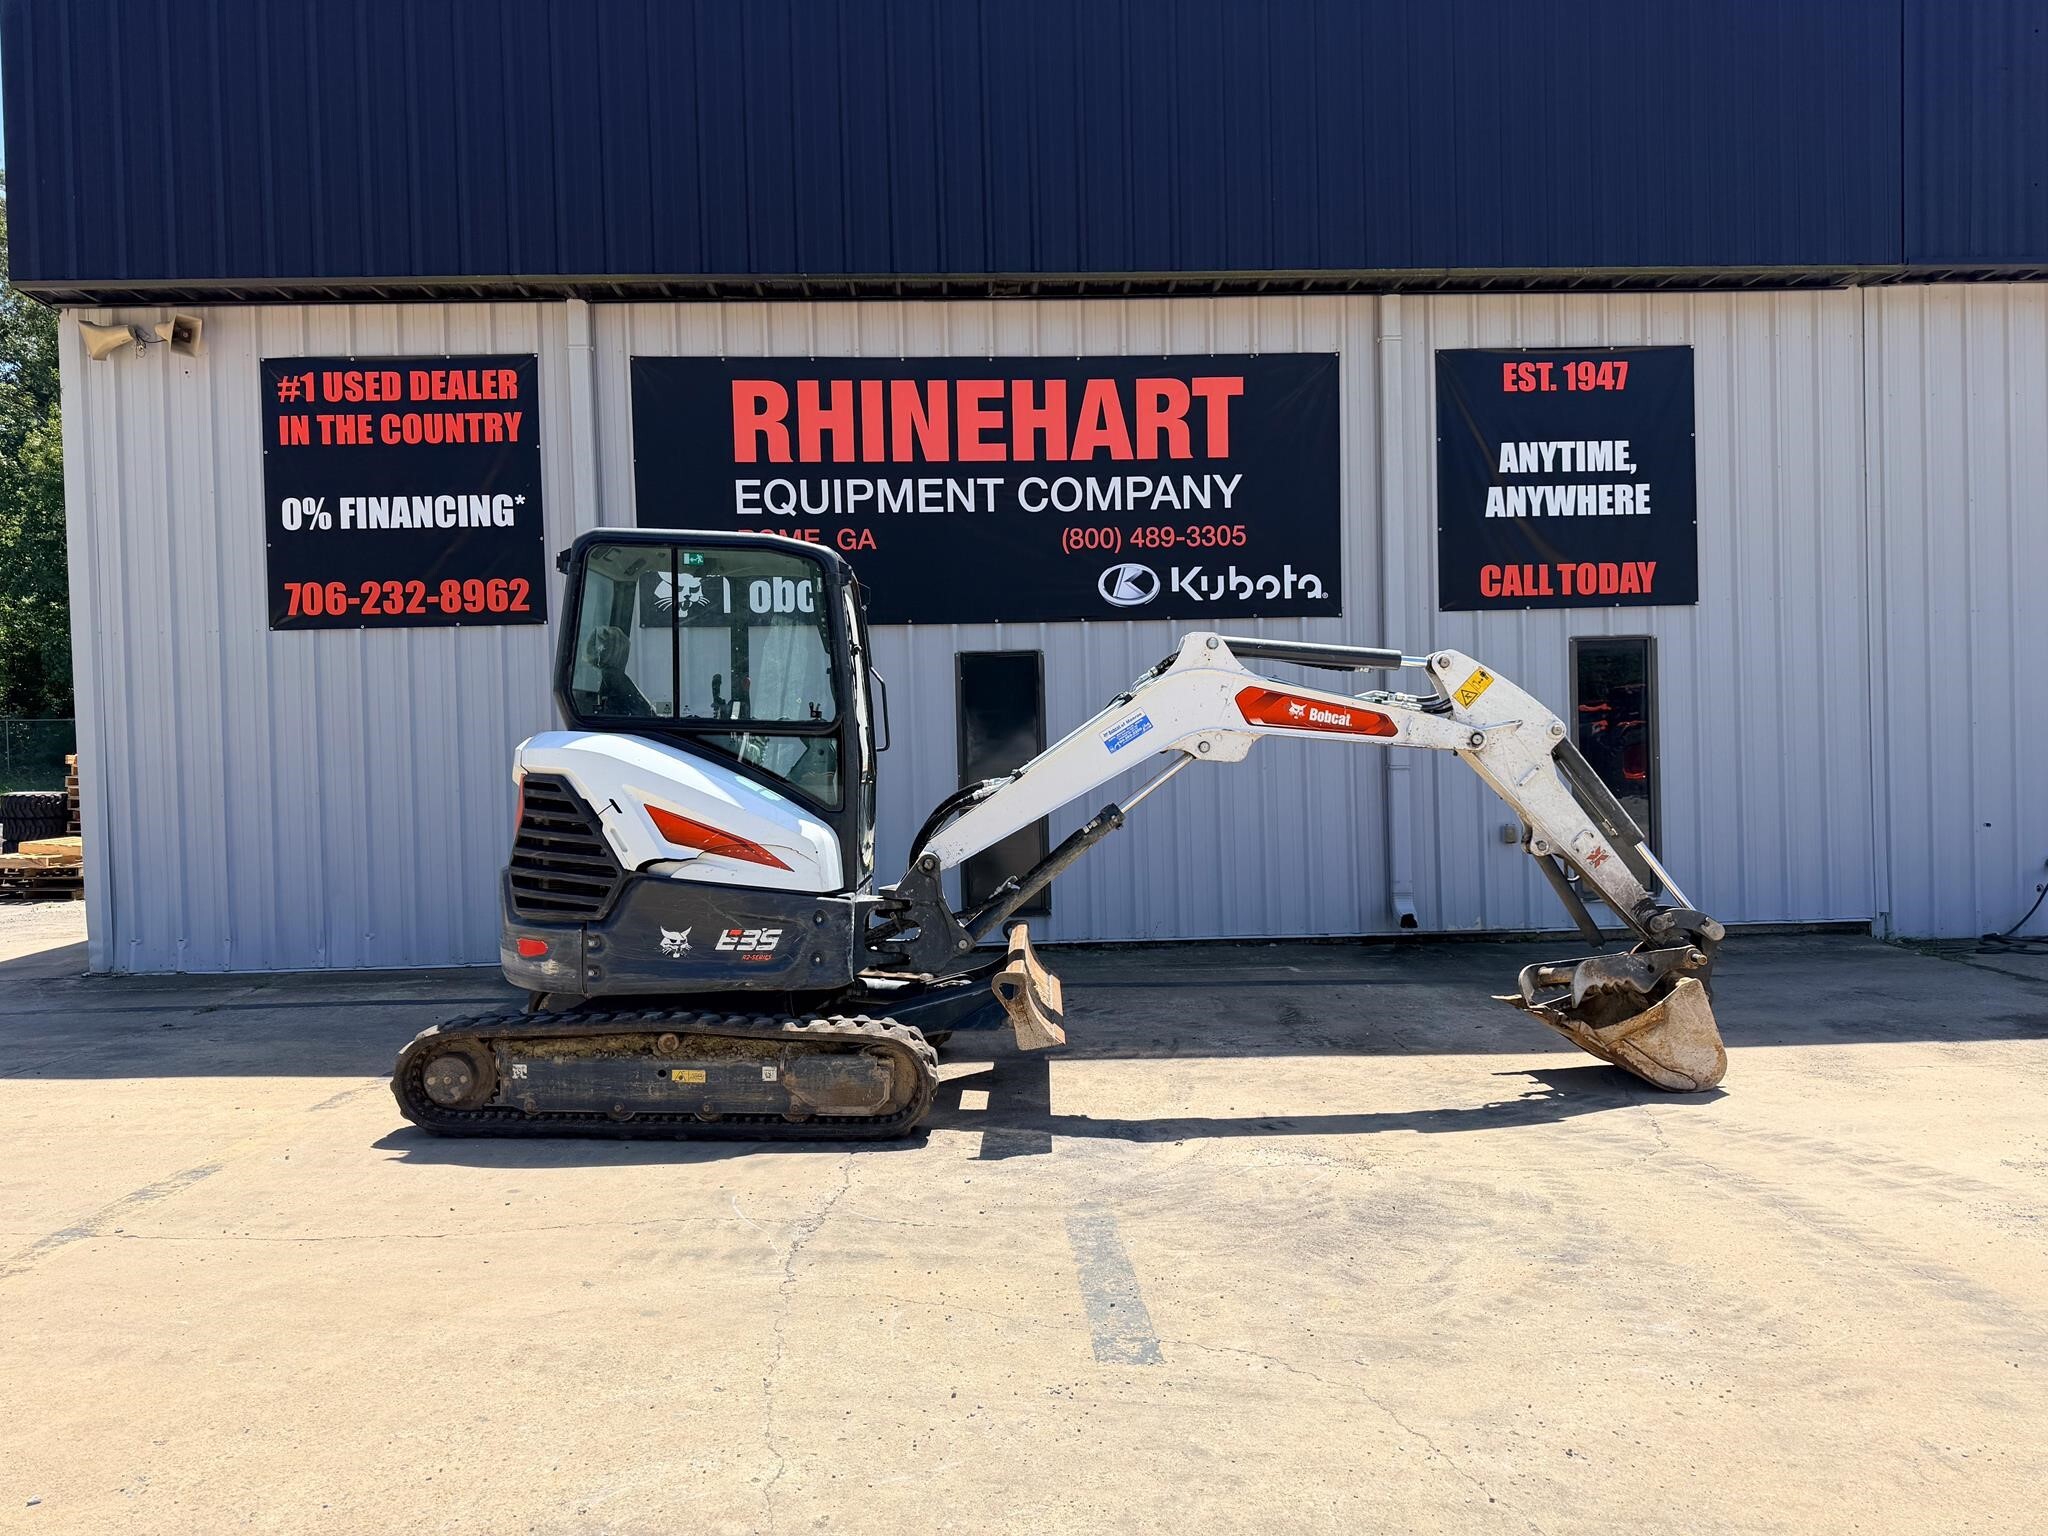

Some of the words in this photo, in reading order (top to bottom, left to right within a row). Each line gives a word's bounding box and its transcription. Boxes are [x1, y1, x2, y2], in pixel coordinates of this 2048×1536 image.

[278, 372, 314, 402] #1
[323, 371, 401, 402] USED
[410, 370, 517, 401] DEALER
[1504, 363, 1557, 392] EST.
[1564, 362, 1628, 391] 1947
[280, 416, 310, 445] IN
[317, 415, 373, 445] THE
[381, 412, 521, 445] COUNTRY
[732, 376, 1244, 462] RHINEHART
[1499, 441, 1636, 474] ANYTIME,
[736, 478, 1004, 515] EQUIPMENT
[1018, 474, 1242, 512] COMPANY
[1486, 484, 1650, 517] ANYWHERE
[282, 497, 331, 530] 0%
[837, 528, 877, 550] GA
[1063, 527, 1122, 554] (800)
[1130, 525, 1246, 548] 489-3305
[1480, 564, 1553, 597] CALL
[1557, 562, 1655, 595] TODAY
[285, 579, 529, 616] 706-232-8962
